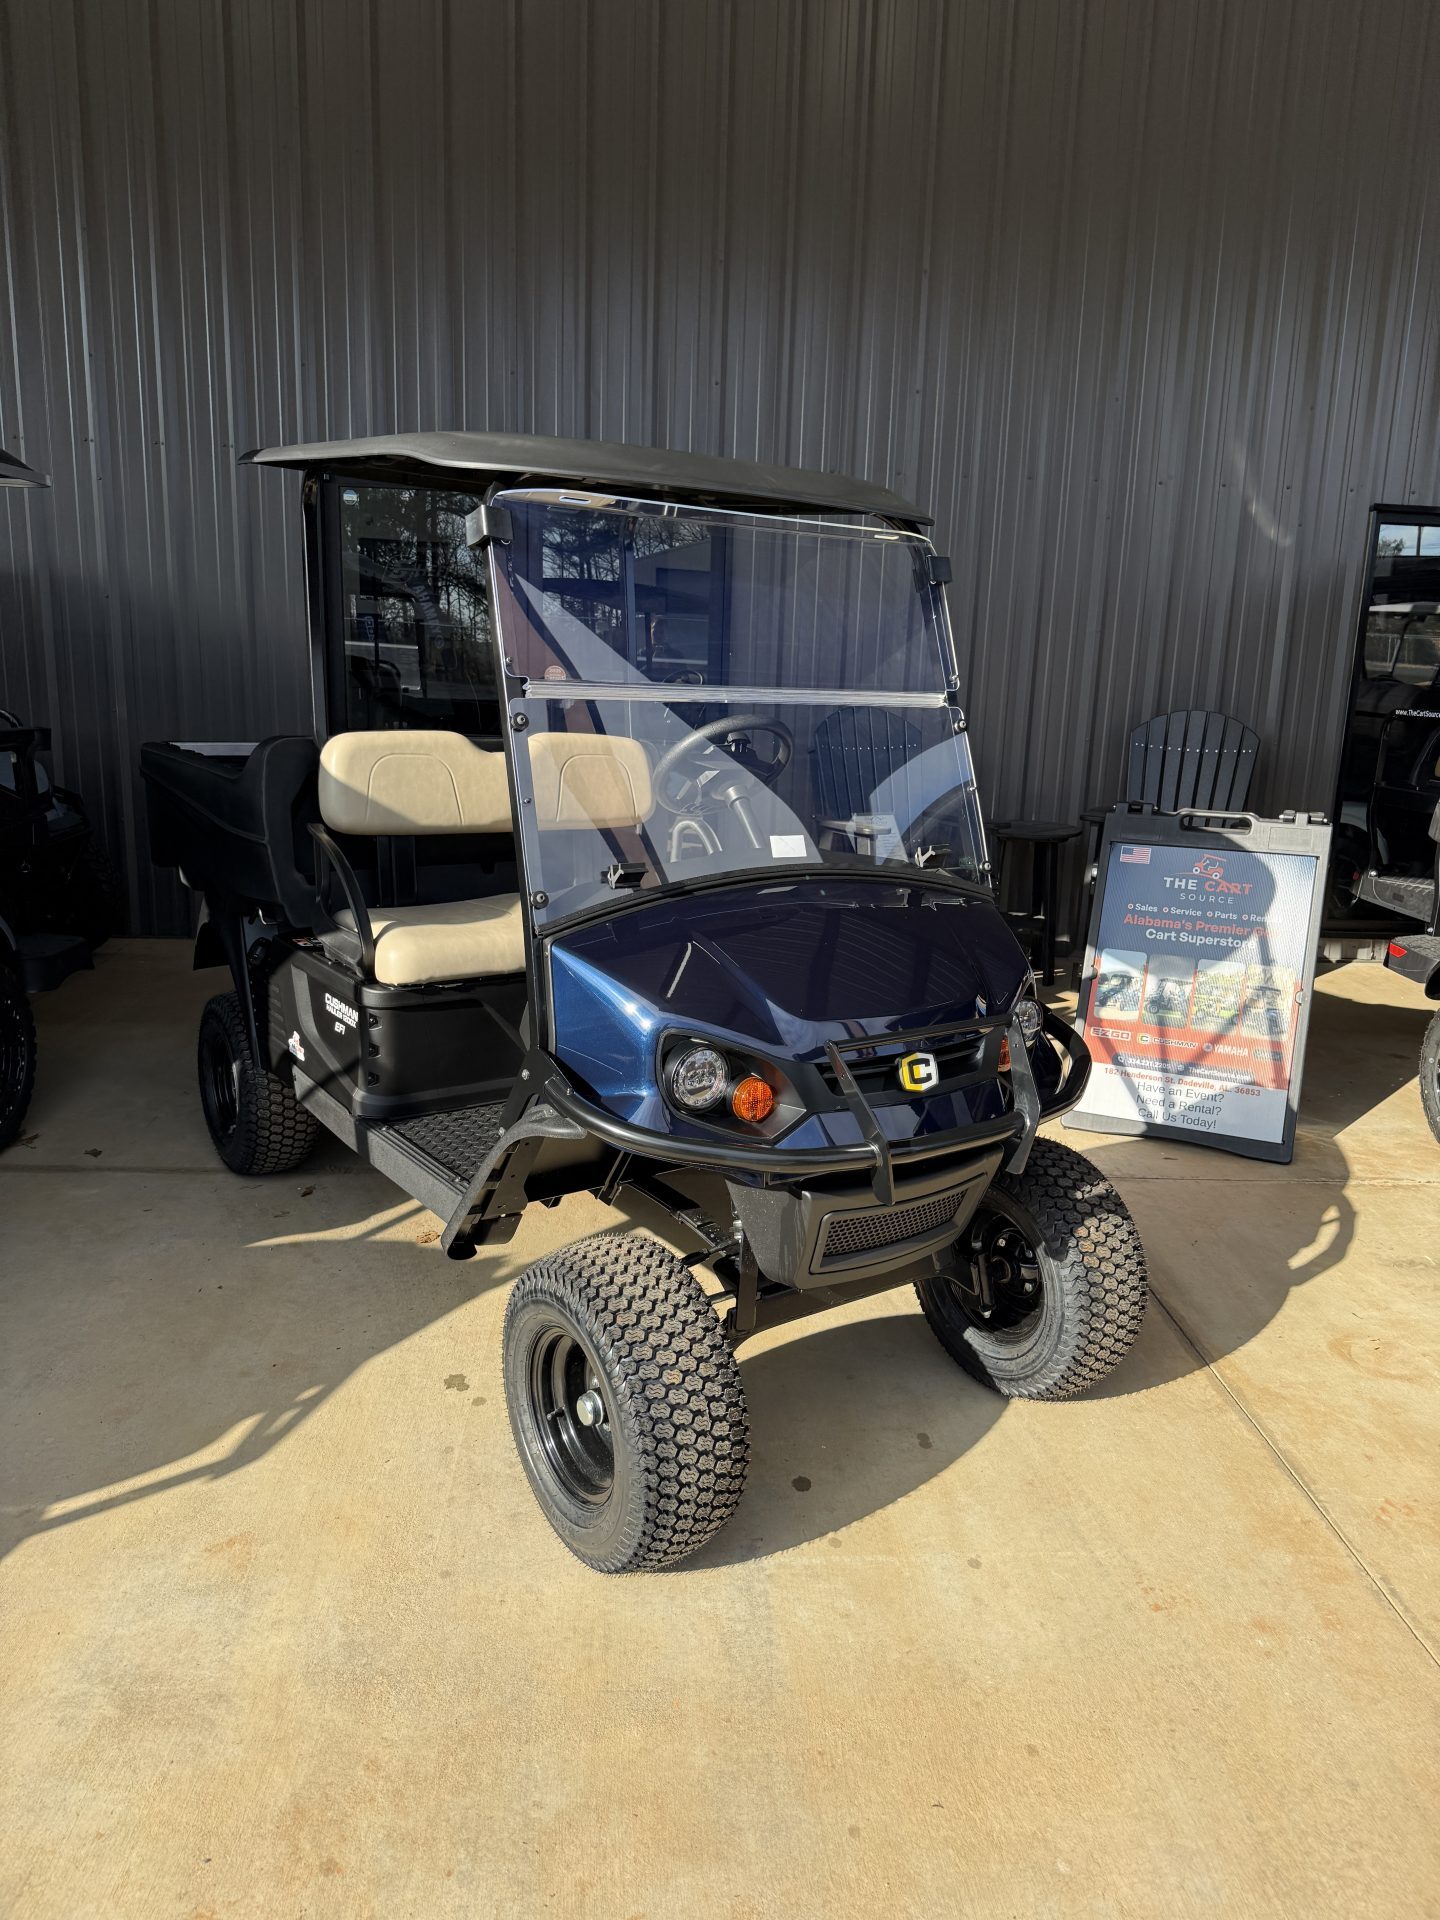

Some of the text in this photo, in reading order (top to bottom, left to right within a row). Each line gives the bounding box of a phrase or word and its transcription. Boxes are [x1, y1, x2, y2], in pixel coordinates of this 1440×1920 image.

[1163, 877, 1253, 895] THE CART
[1180, 893, 1234, 904] SOURCE
[1135, 903, 1158, 912] Sales
[1170, 907, 1202, 916] Service
[1214, 911, 1238, 920] Parts
[1124, 913, 1193, 930] Alabama's
[1196, 921, 1250, 936] Premier
[1145, 928, 1255, 948] Cart Superstore
[325, 992, 359, 1022] CUSHMAN
[334, 1021, 346, 1035] EFI
[1214, 1044, 1249, 1056] YAMAHA
[1104, 1067, 1119, 1075] 182
[1120, 1069, 1163, 1082] Henderson
[1178, 1078, 1216, 1091] Dadeville,
[1234, 1086, 1261, 1096] 36853
[1137, 1082, 1225, 1103] Have an Event?
[1136, 1094, 1222, 1116] Need a Rental?
[1138, 1107, 1217, 1130] Call Us Today!
